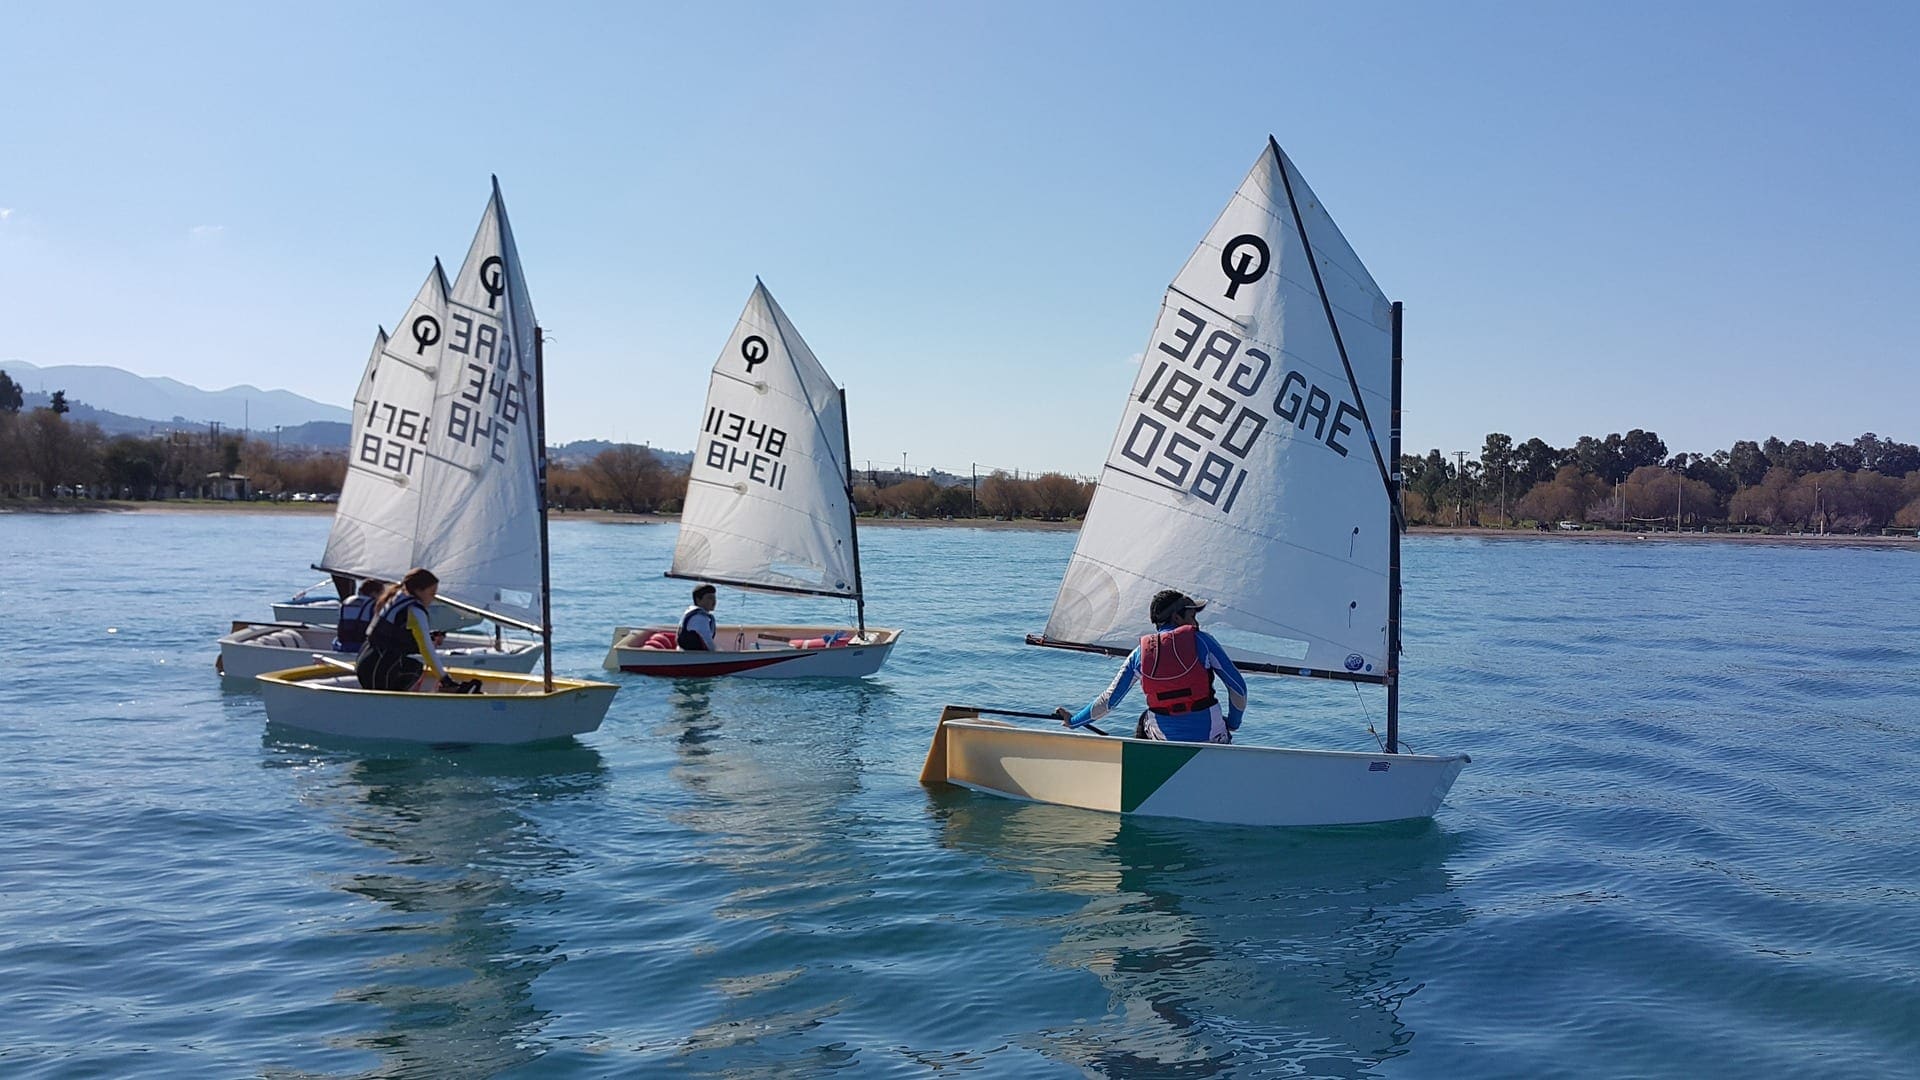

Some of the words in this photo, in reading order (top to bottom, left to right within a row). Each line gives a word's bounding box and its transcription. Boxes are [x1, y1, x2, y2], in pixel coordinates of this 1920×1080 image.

[704, 406, 787, 457] 11348
[1137, 361, 1268, 460] 1820
[1272, 370, 1362, 458] GRE
